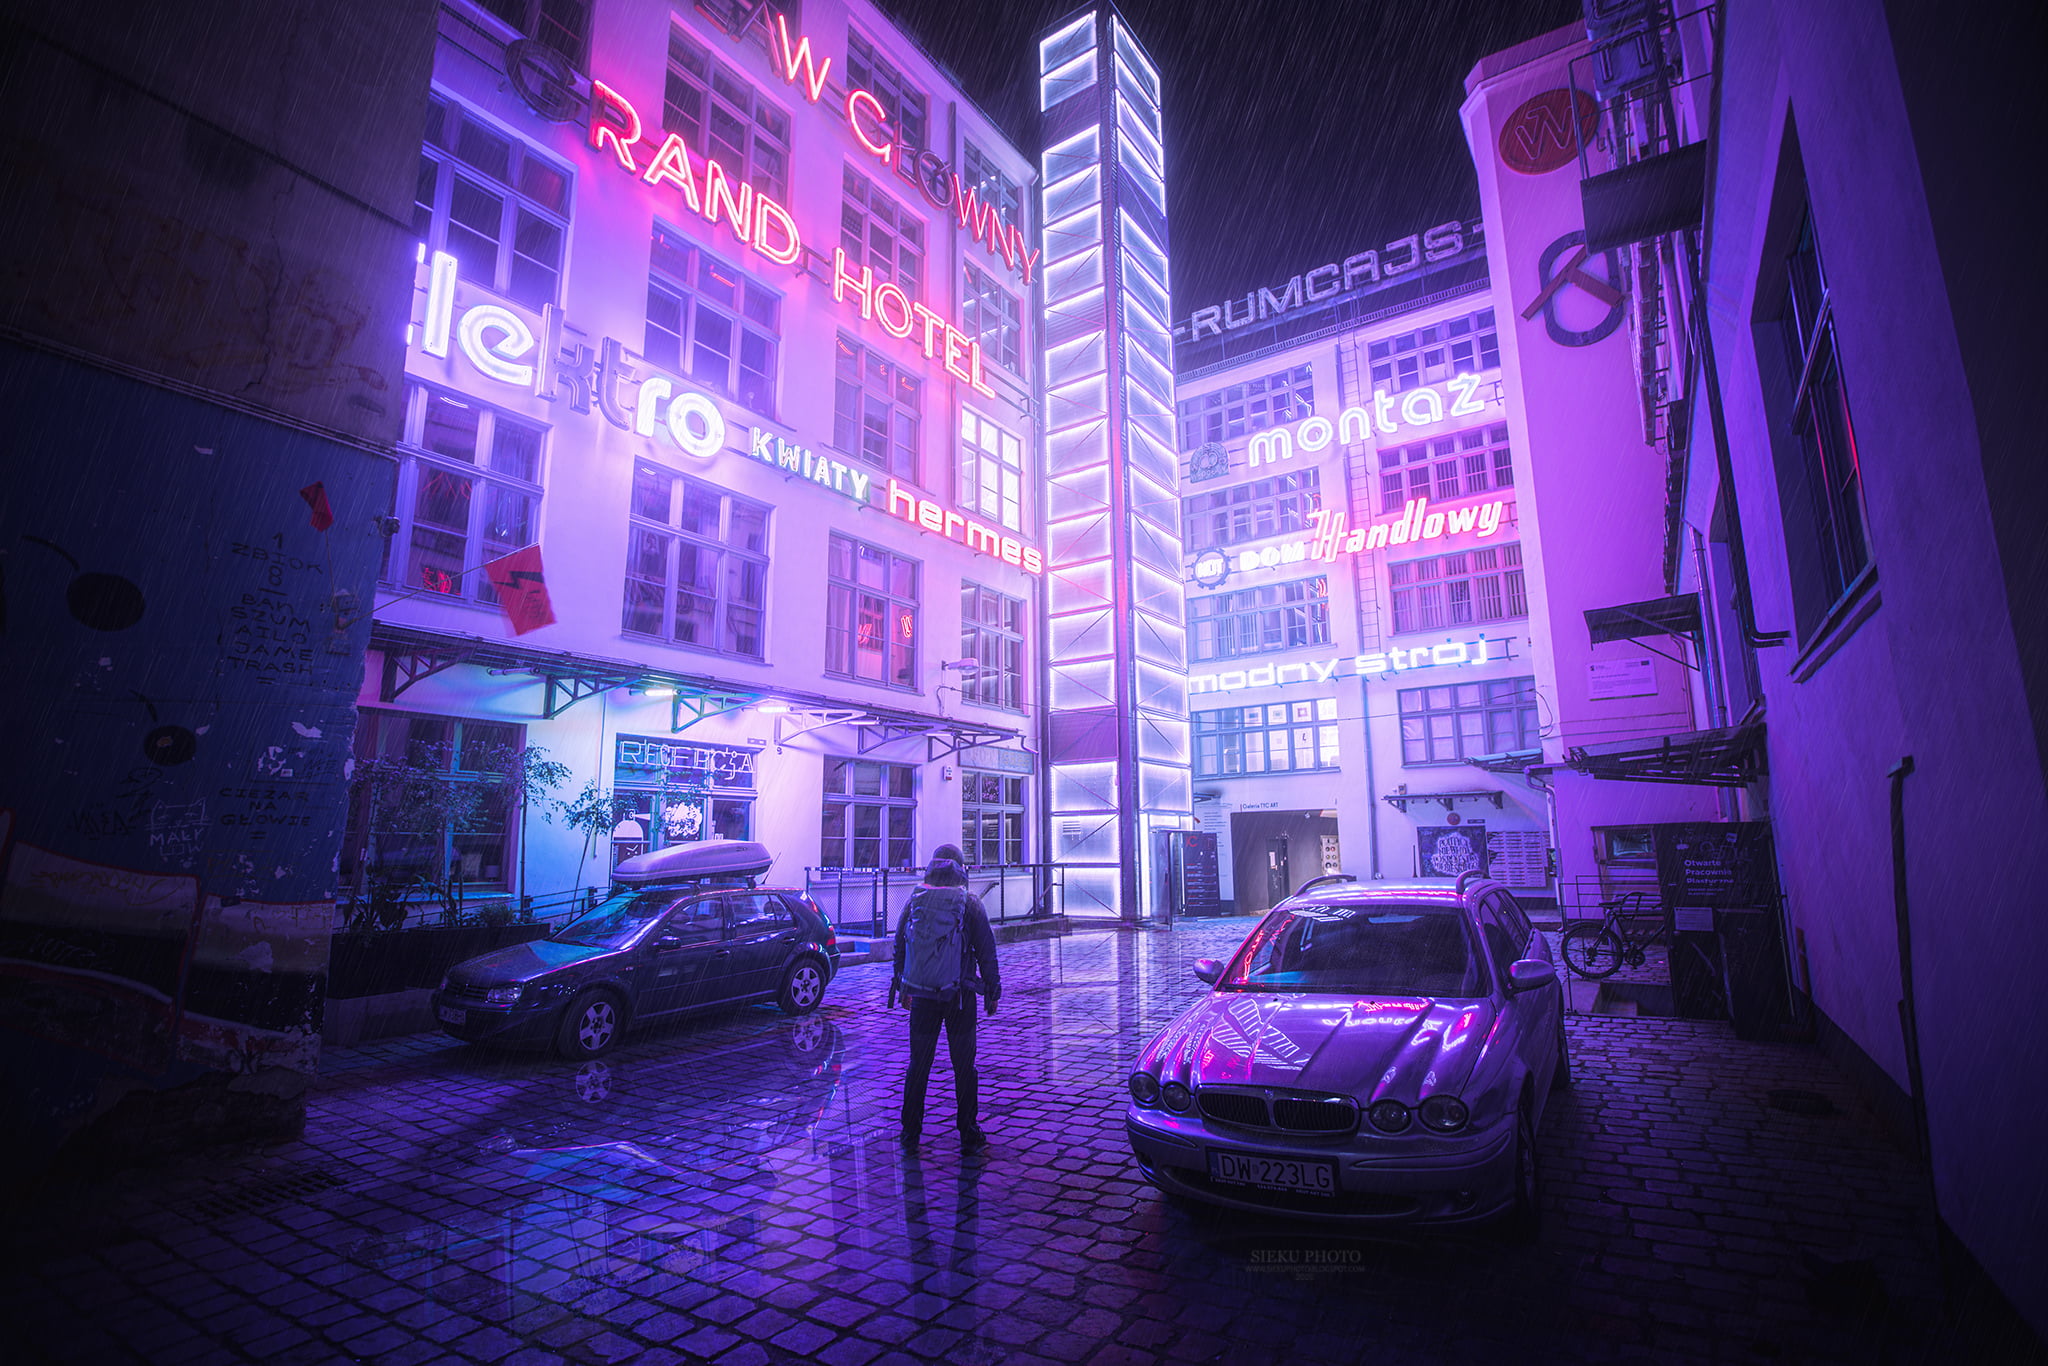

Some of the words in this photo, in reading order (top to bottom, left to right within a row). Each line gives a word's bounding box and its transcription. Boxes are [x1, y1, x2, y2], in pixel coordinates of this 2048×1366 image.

[504, 37, 801, 266] GRAND
[831, 246, 995, 399] HOTEL
[406, 241, 726, 458] lektro
[750, 425, 872, 503] KWIATY
[885, 478, 1044, 576] hermes
[1306, 496, 1505, 564] Handlowy
[1189, 658, 1340, 693] modny
[1222, 1156, 1251, 1180] DW
[1260, 1161, 1330, 1188] 223LG
